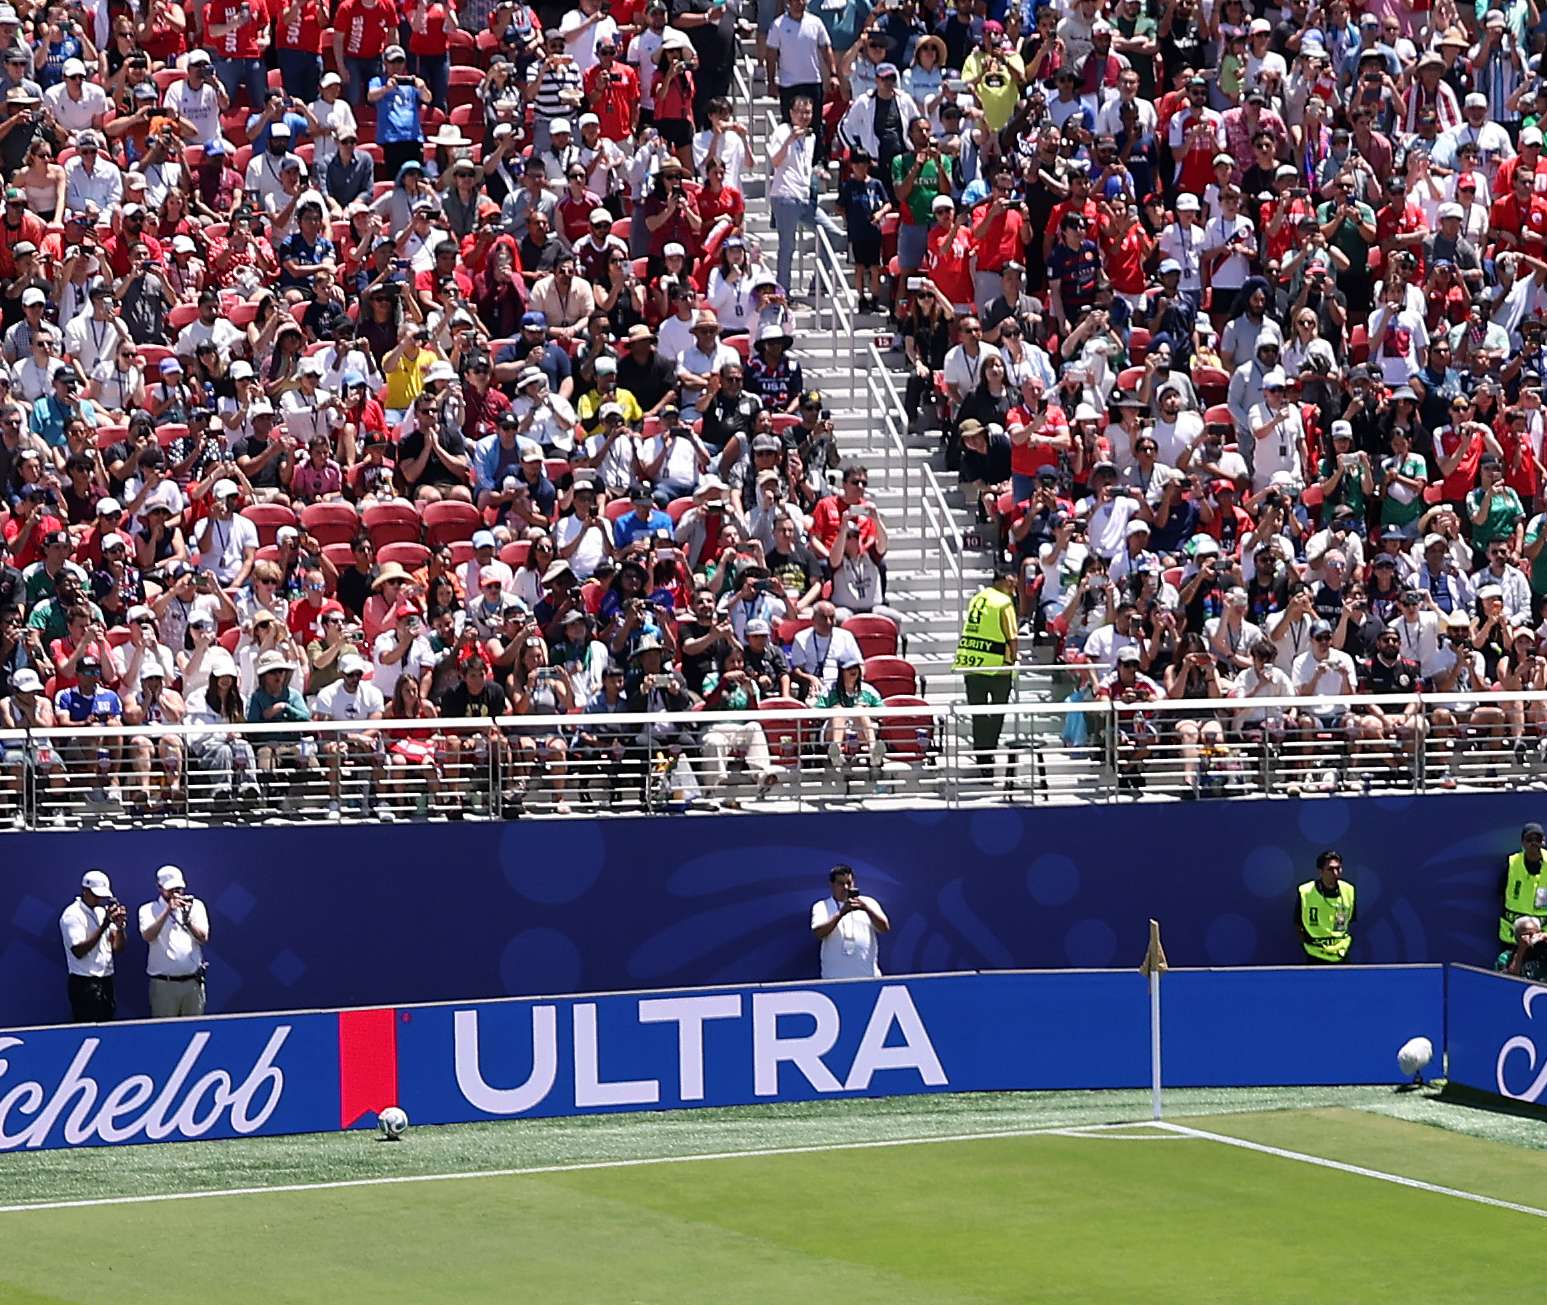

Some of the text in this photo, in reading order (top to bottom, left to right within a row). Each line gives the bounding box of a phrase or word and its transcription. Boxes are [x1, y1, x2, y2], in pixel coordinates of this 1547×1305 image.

[761, 381, 789, 392] USA
[965, 536, 978, 547] 10
[959, 637, 993, 652] CURITY
[453, 984, 950, 1115] ULTRA
[0, 1024, 292, 1151] chelob
